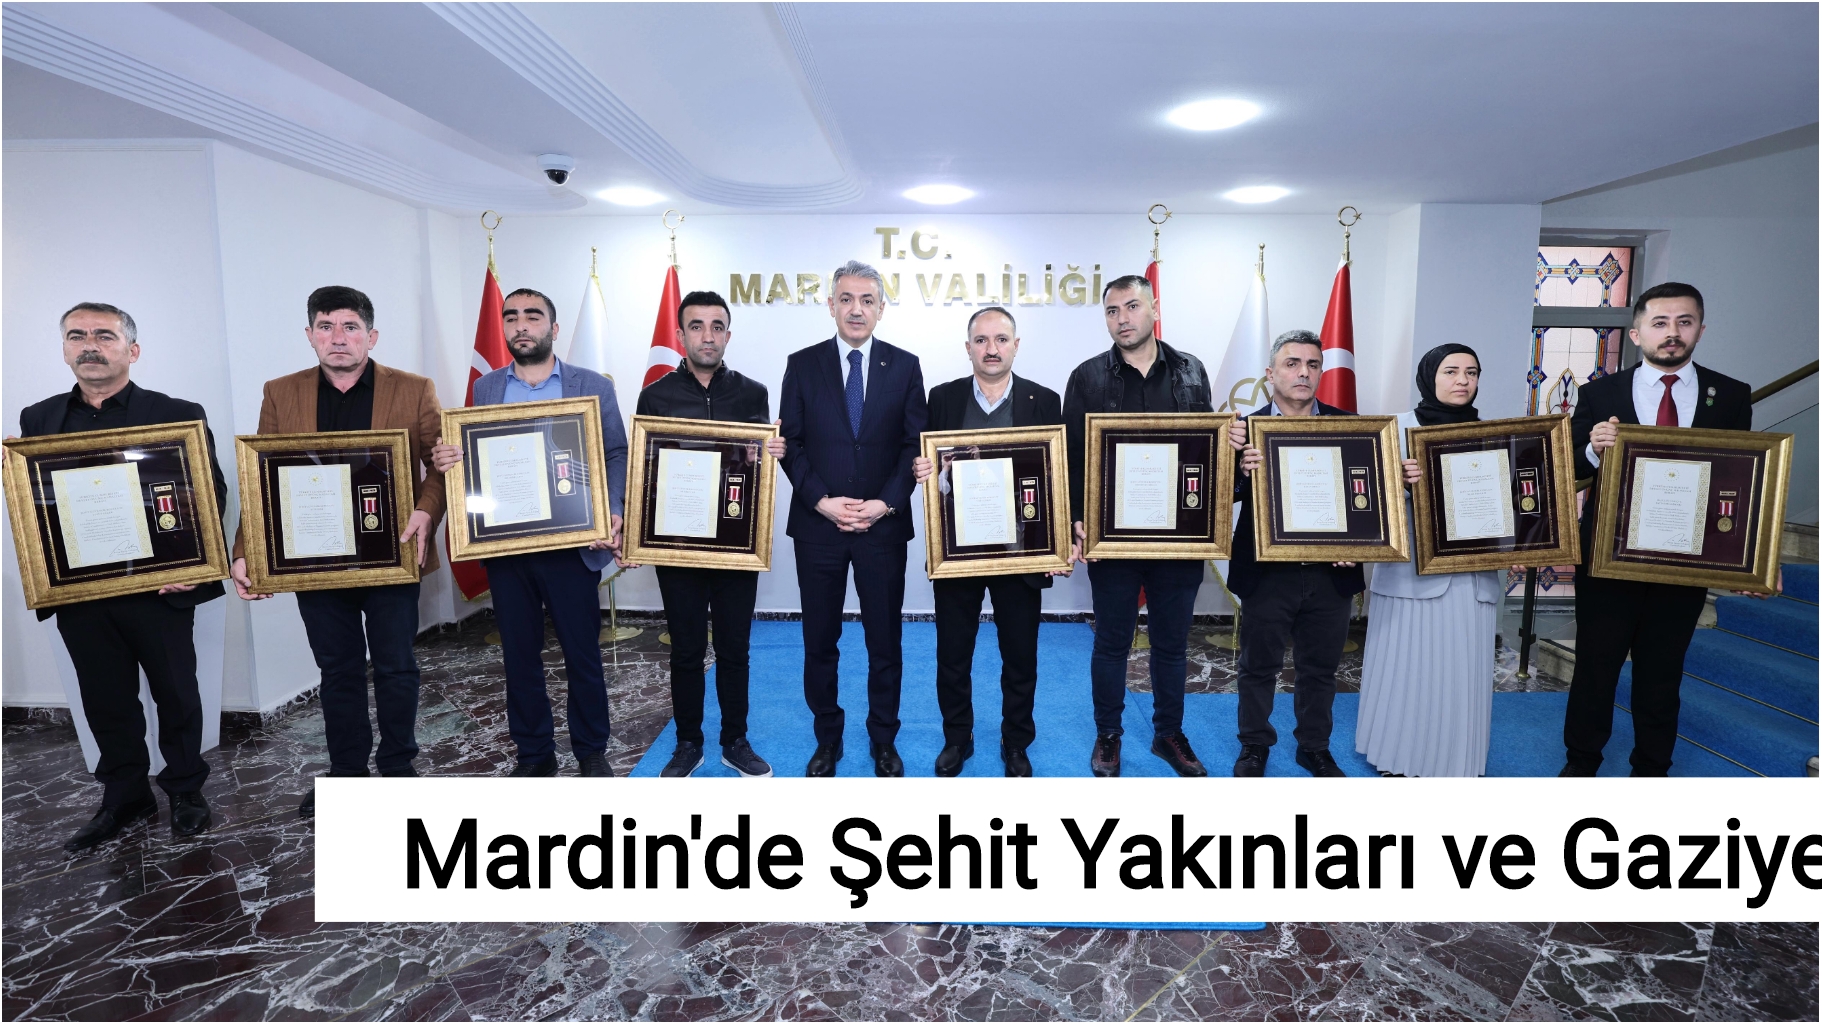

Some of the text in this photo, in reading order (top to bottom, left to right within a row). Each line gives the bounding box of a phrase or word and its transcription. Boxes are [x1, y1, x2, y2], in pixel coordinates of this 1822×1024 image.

[875, 227, 952, 260] T.C.
[730, 263, 1102, 306] MARN VALİLİĞİ
